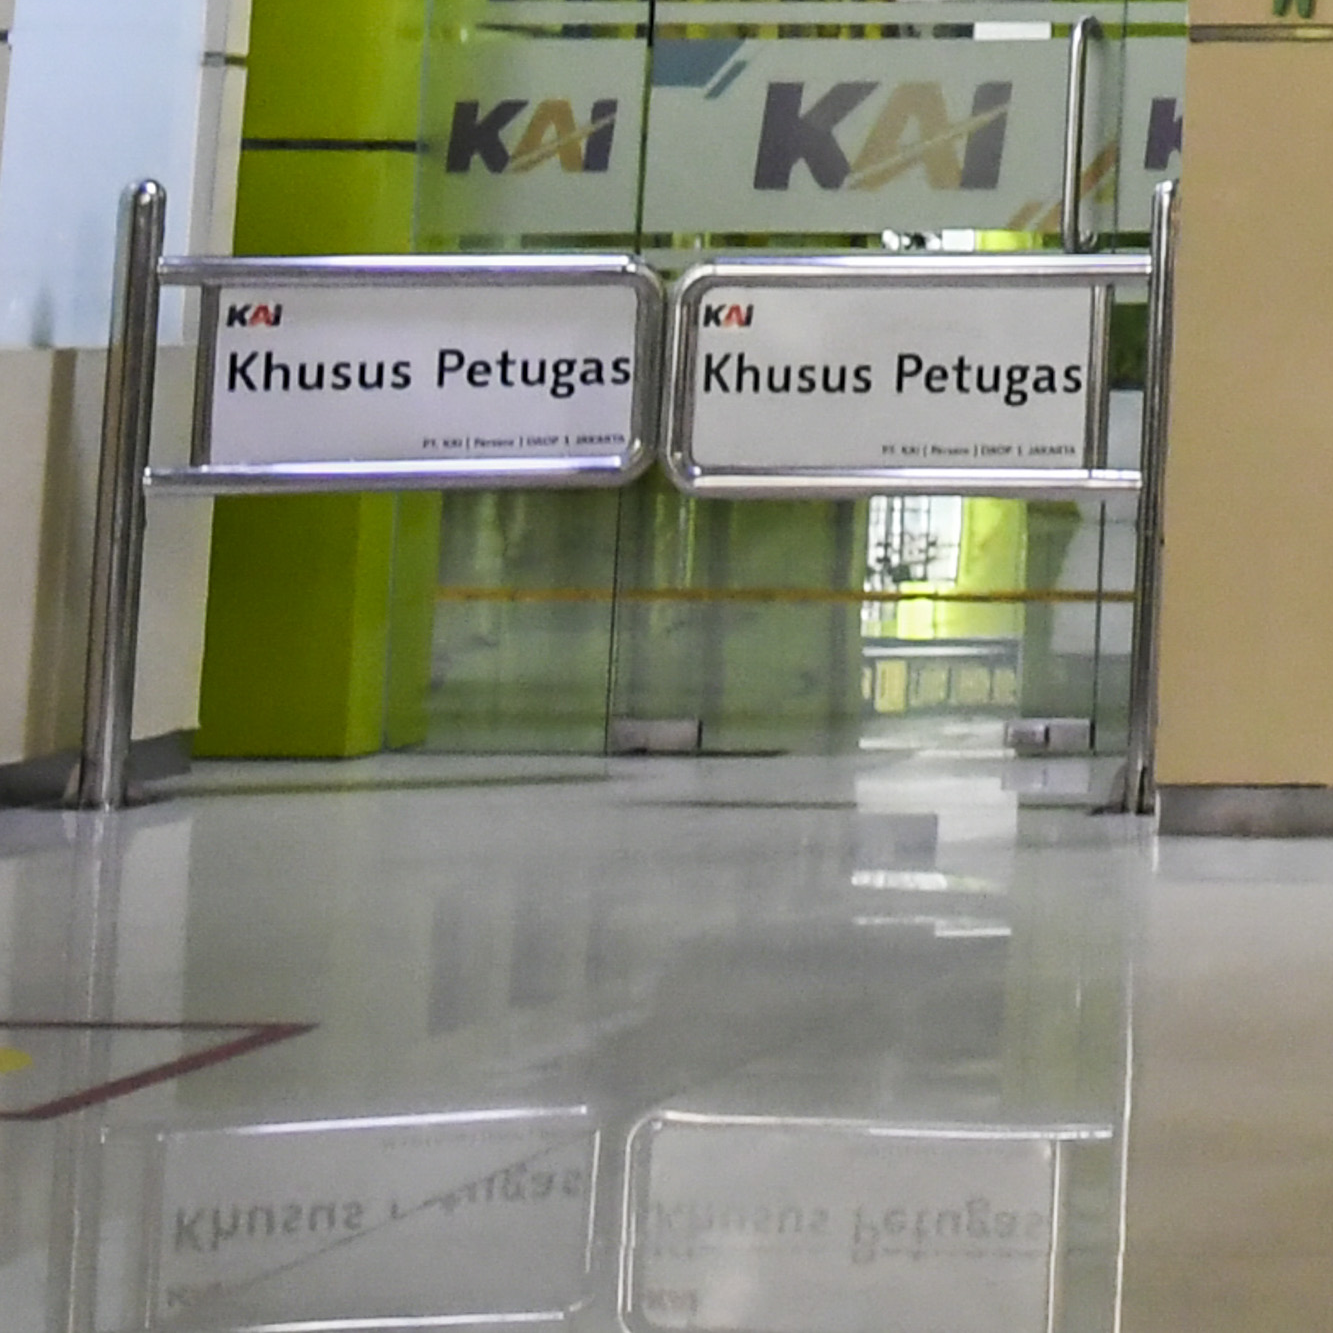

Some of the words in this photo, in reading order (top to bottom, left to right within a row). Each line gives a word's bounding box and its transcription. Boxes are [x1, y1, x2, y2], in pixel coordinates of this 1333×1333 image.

[446, 99, 618, 173] KAI
[754, 81, 1013, 191] KAI
[226, 303, 282, 328] KAI
[704, 303, 754, 328] KAI
[227, 350, 412, 393] Khusus
[437, 348, 631, 399] Petugas
[703, 353, 872, 394] Khusus
[895, 353, 1083, 407] Petugas
